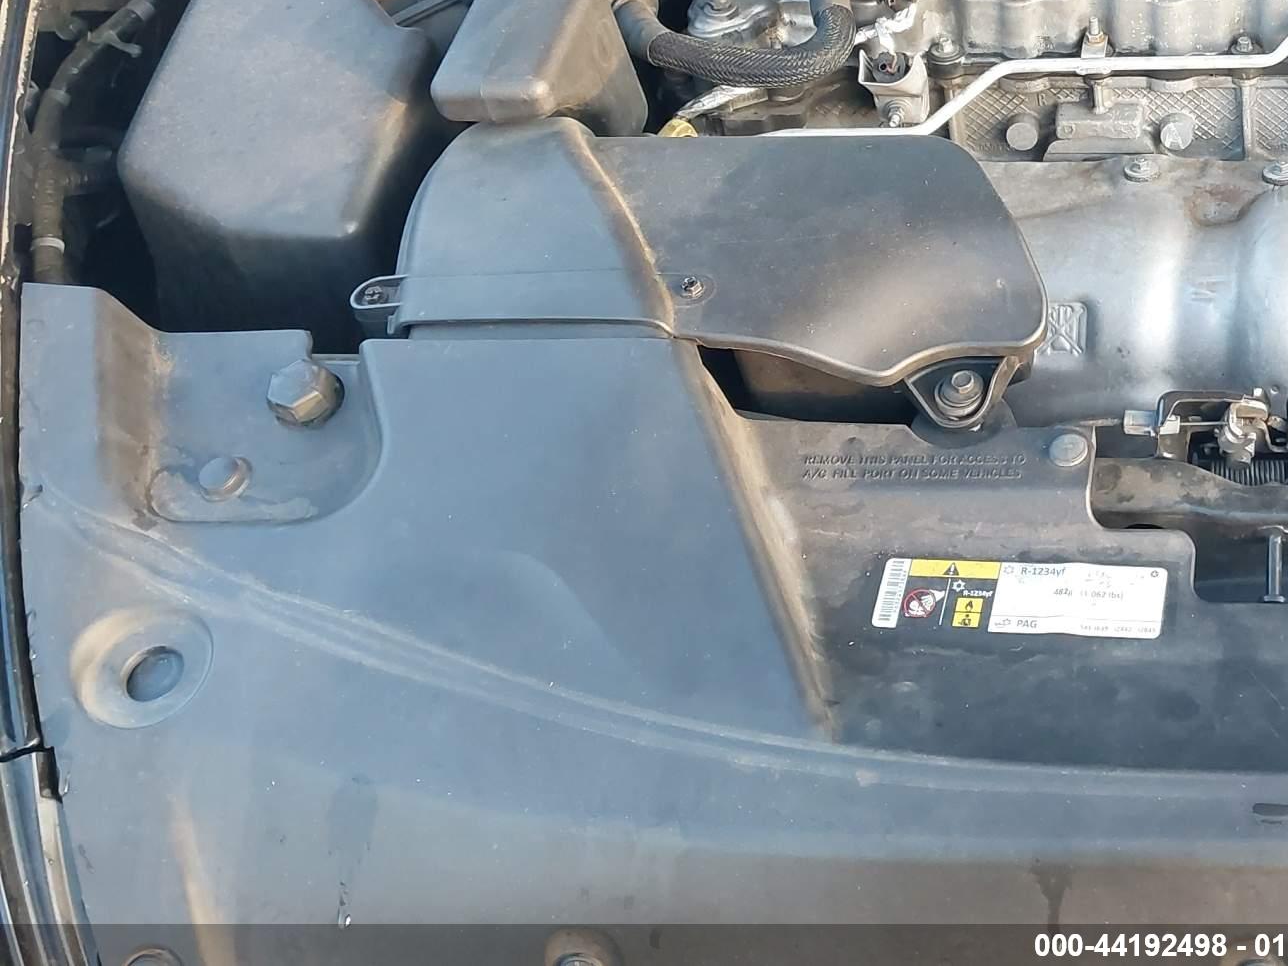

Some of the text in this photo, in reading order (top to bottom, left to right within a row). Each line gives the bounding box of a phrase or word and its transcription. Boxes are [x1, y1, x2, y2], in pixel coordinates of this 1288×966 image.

[804, 455, 856, 466] REMOVE
[860, 455, 887, 466] THIS
[931, 455, 958, 466] FOR
[959, 455, 1008, 466] ACCESS
[1011, 455, 1026, 465] TO
[832, 469, 857, 480] FILL
[862, 469, 897, 480] PORT
[899, 469, 920, 480] ON
[922, 469, 959, 480] SOME
[964, 469, 1023, 480] VEHICLES
[1020, 565, 1066, 577] R-1234yf
[1016, 619, 1038, 629] PAG
